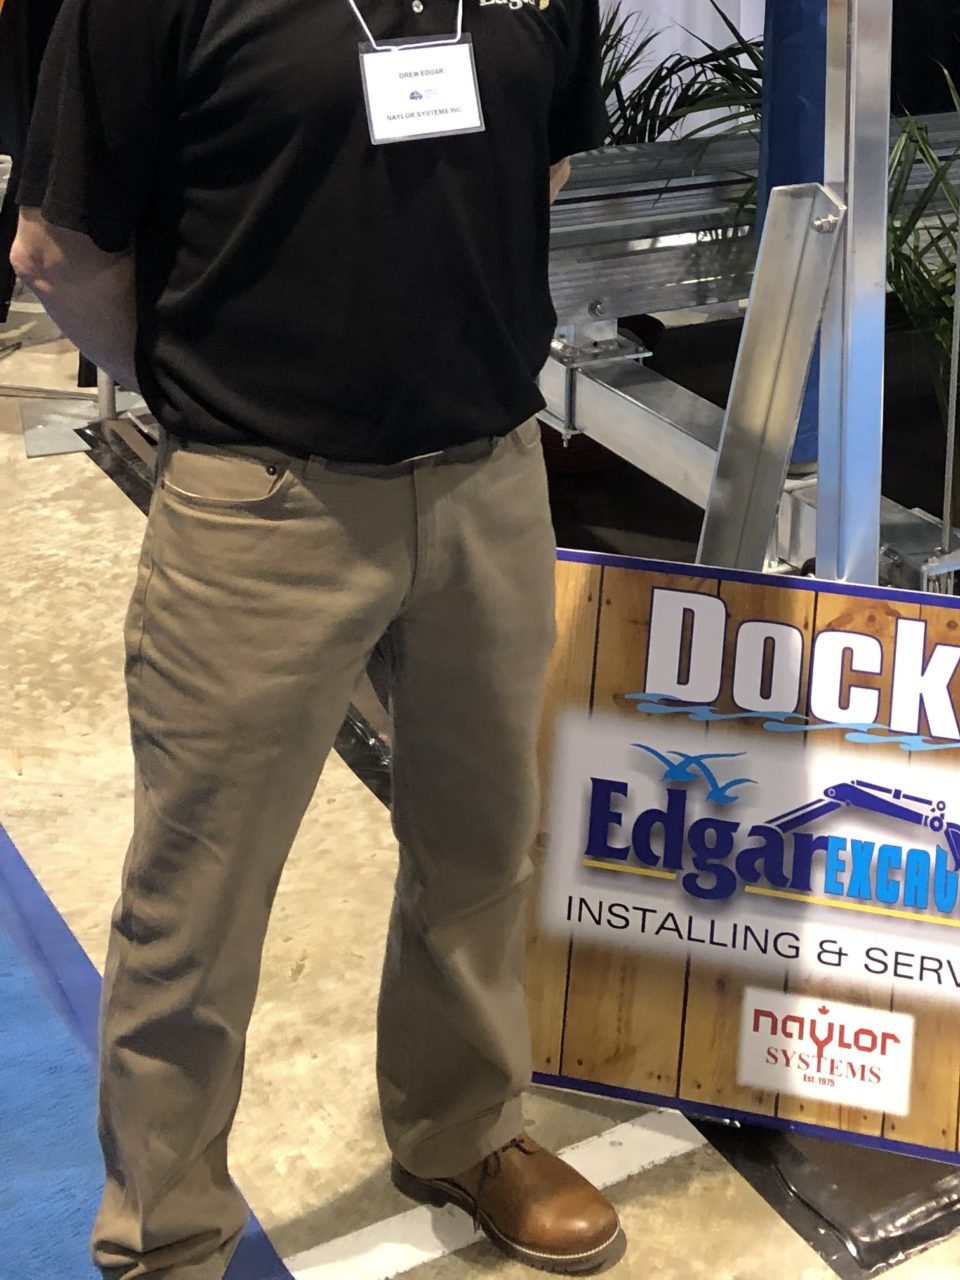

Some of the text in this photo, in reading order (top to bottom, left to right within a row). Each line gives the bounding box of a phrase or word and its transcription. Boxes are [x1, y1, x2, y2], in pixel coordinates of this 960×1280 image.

[399, 68, 444, 79] DREW EDGAR
[386, 111, 415, 121] NAYLOR
[416, 107, 449, 117] SYSTEMS
[584, 777, 829, 901] Edgar
[566, 896, 801, 959] INSTALLING
[816, 939, 849, 967] &
[765, 1046, 882, 1084] SYSTEMS
[818, 1077, 835, 1087] 1975
